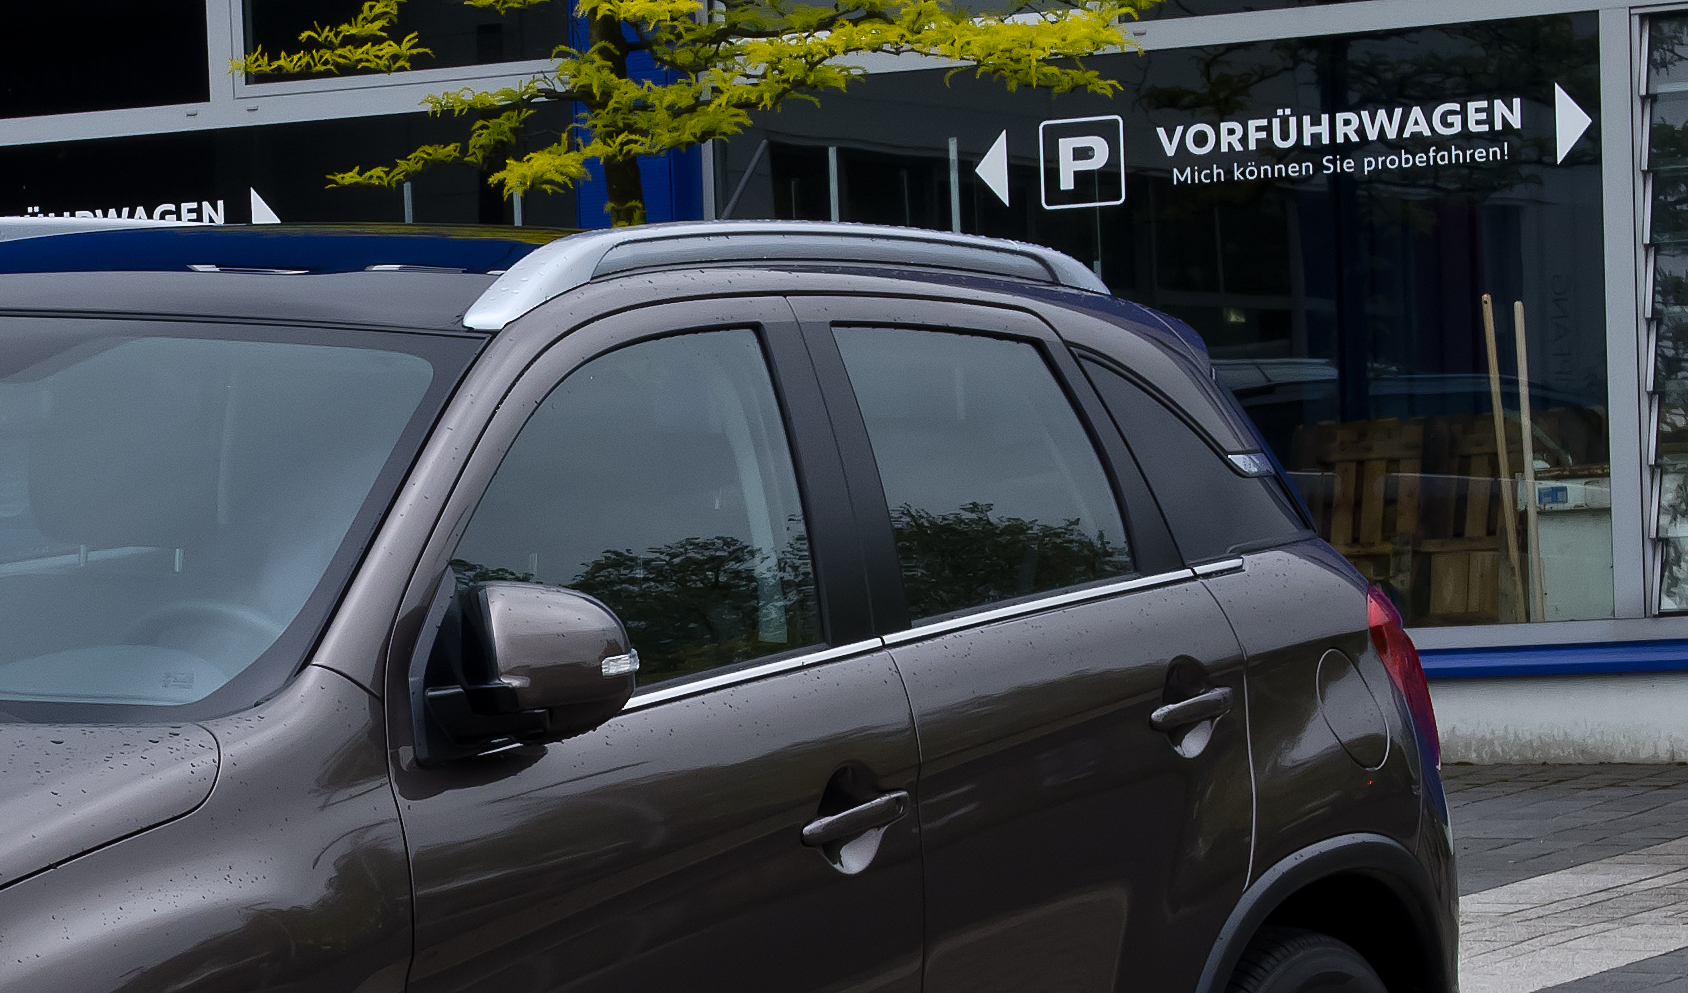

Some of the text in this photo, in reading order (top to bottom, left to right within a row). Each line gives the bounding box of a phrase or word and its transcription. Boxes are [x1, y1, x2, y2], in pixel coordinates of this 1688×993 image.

[1156, 97, 1522, 157] VORFÜHRWAGEN
[1058, 135, 1110, 191] P
[1172, 141, 1509, 186] Mich können Sie probefahren!
